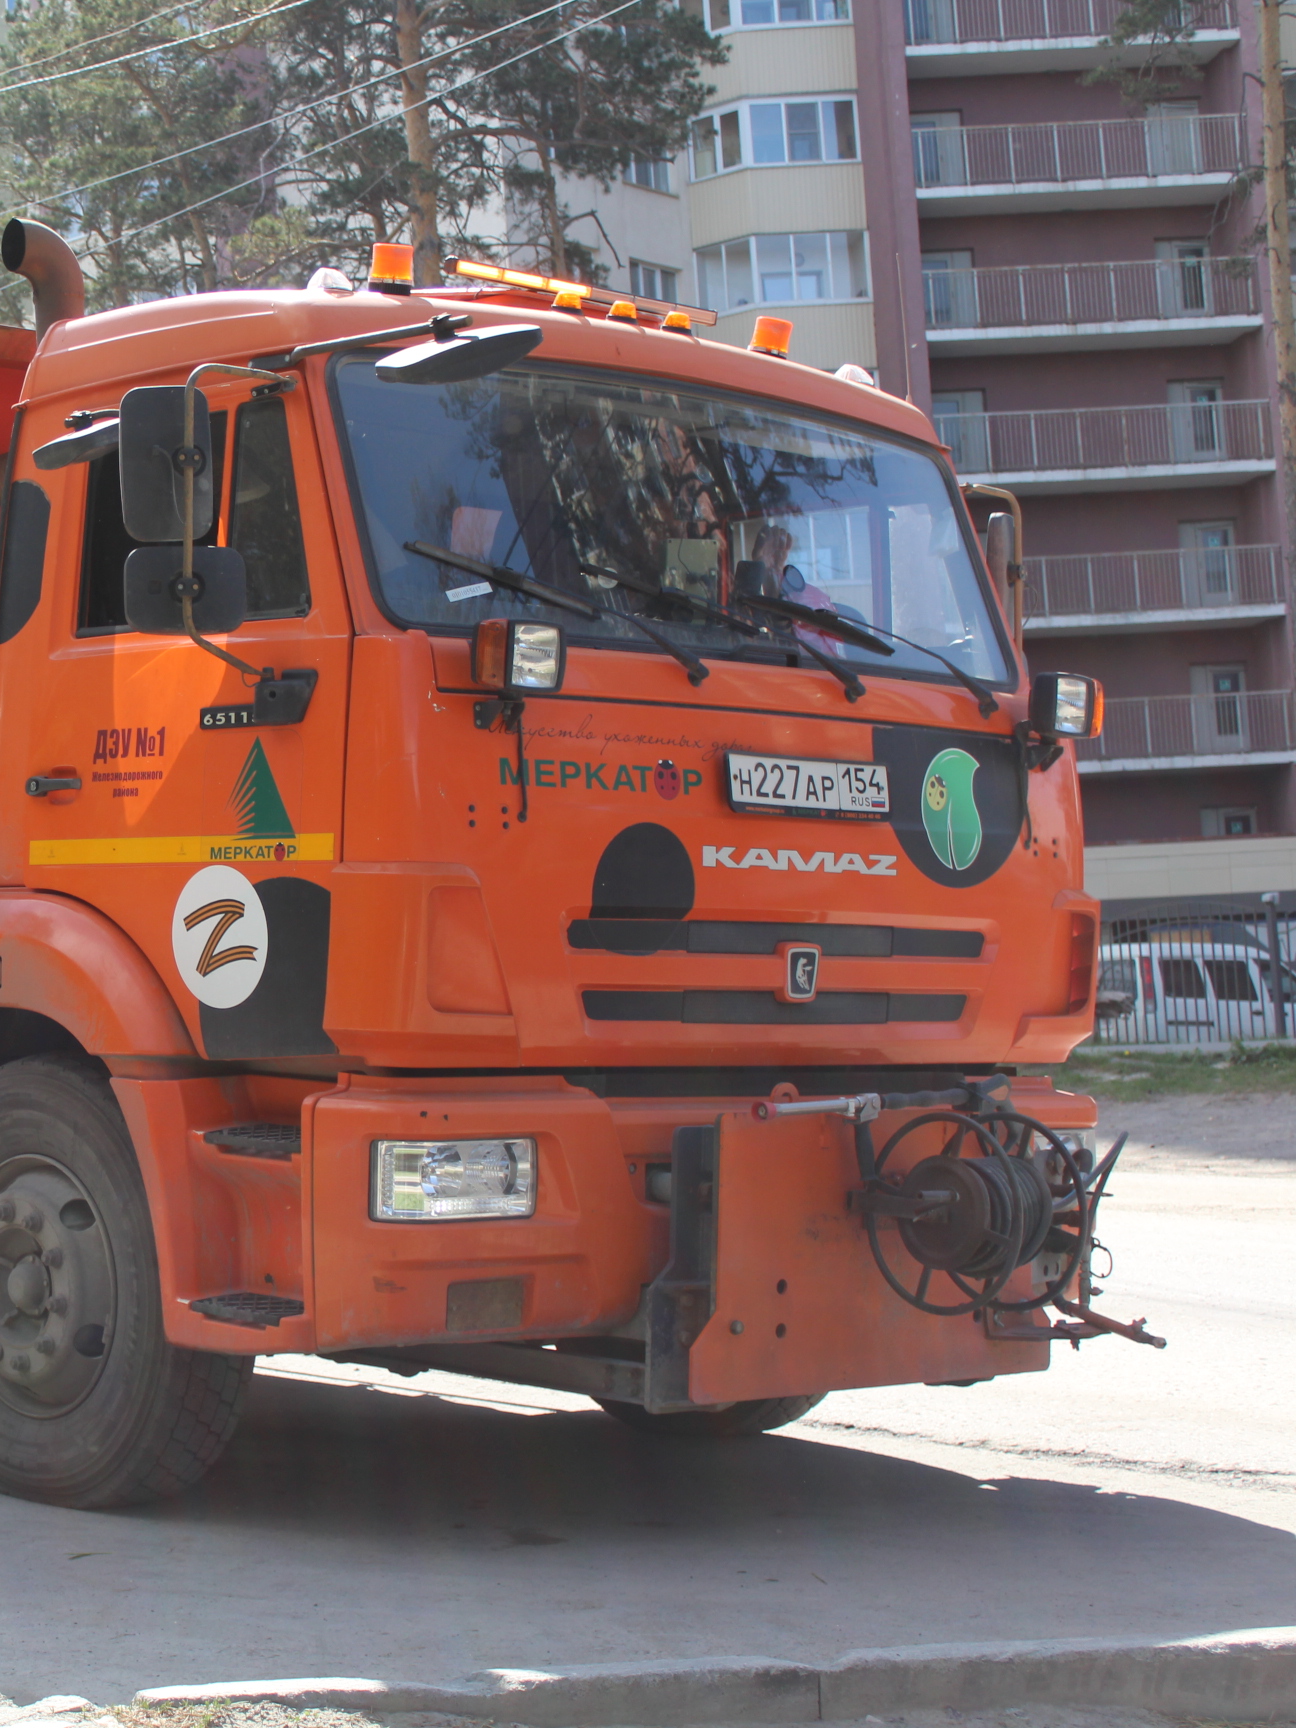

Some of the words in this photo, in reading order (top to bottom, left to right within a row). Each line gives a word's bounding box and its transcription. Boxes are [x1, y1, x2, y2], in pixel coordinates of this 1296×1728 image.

[203, 711, 255, 726] 6511
[93, 728, 132, 765] ДЭУ
[135, 726, 166, 757] №1
[91, 770, 163, 783] Железнодорожного
[842, 767, 882, 796] 154
[112, 786, 139, 798] района
[850, 797, 871, 807] RUS
[702, 845, 897, 876] KAMAZ
[183, 898, 258, 978] Z
